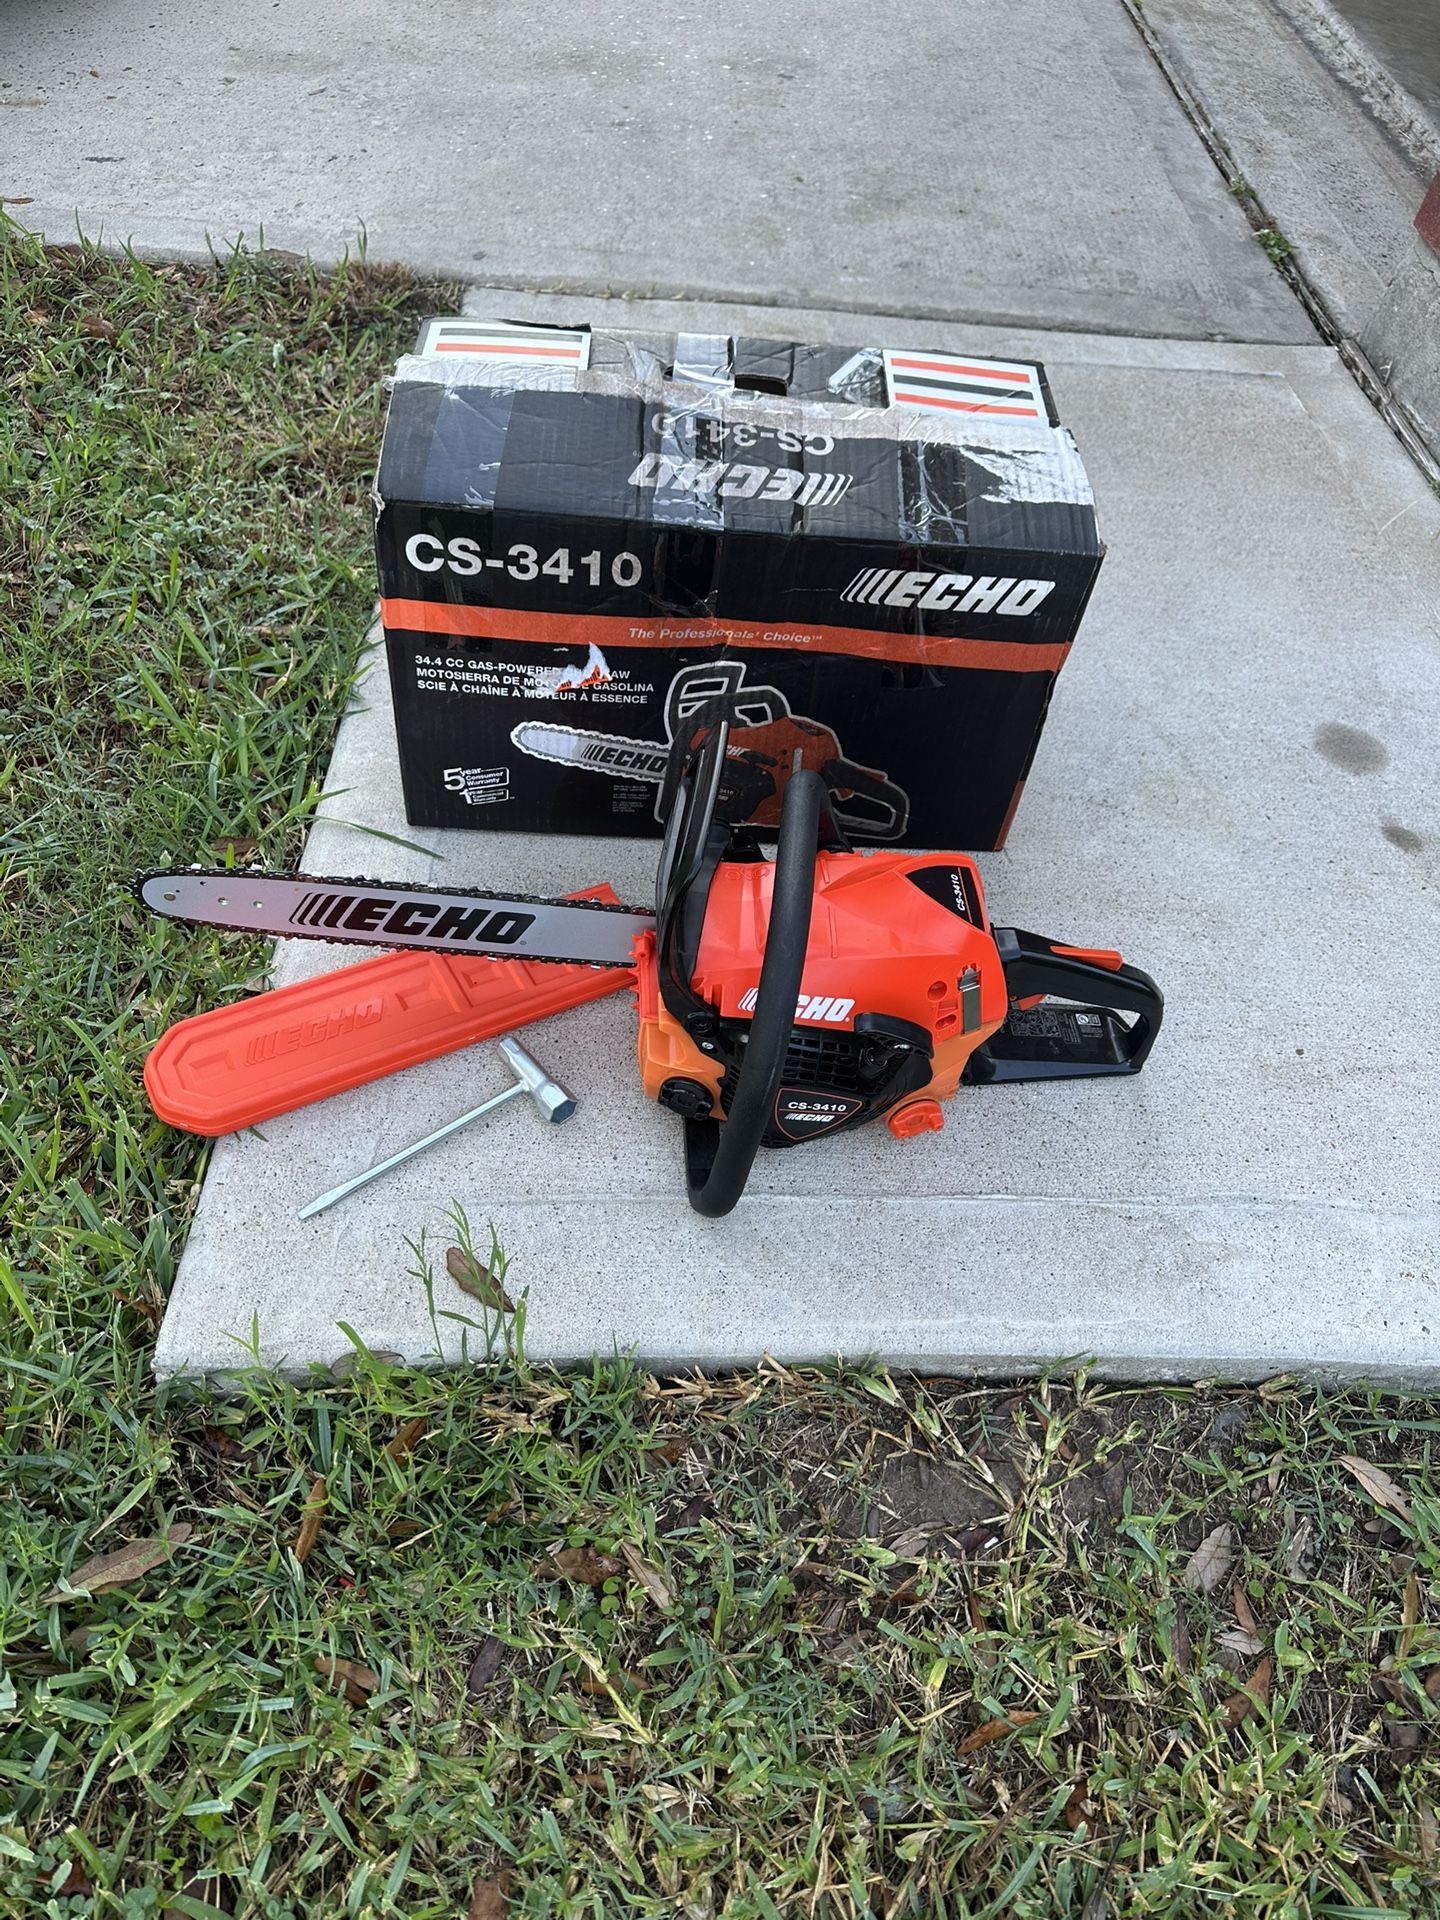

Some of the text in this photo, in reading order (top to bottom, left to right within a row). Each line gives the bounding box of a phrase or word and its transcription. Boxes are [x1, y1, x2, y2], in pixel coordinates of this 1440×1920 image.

[628, 453, 805, 501] ECHO
[405, 533, 643, 588] CS-3410
[884, 570, 1056, 616] ECHO
[629, 627, 655, 640] The
[415, 654, 443, 667] 34.4
[446, 657, 464, 668] CC
[416, 667, 500, 684] MOTOSIERRA
[503, 675, 520, 686] DE
[593, 682, 655, 692] GASOLINA
[417, 679, 648, 704] SCIE À CHAÎNE À MOTEUR À ESSENCE
[599, 746, 669, 773] ECHO
[443, 767, 482, 791] 5 year
[465, 771, 504, 781] Consumer
[466, 777, 500, 787] Warranty
[459, 788, 473, 804] 1
[950, 873, 966, 911] CS-3410
[343, 896, 537, 944] ECHO
[276, 997, 386, 1057] ECHO
[787, 1101, 847, 1112] CS-3410
[796, 1113, 836, 1122] ECHO
